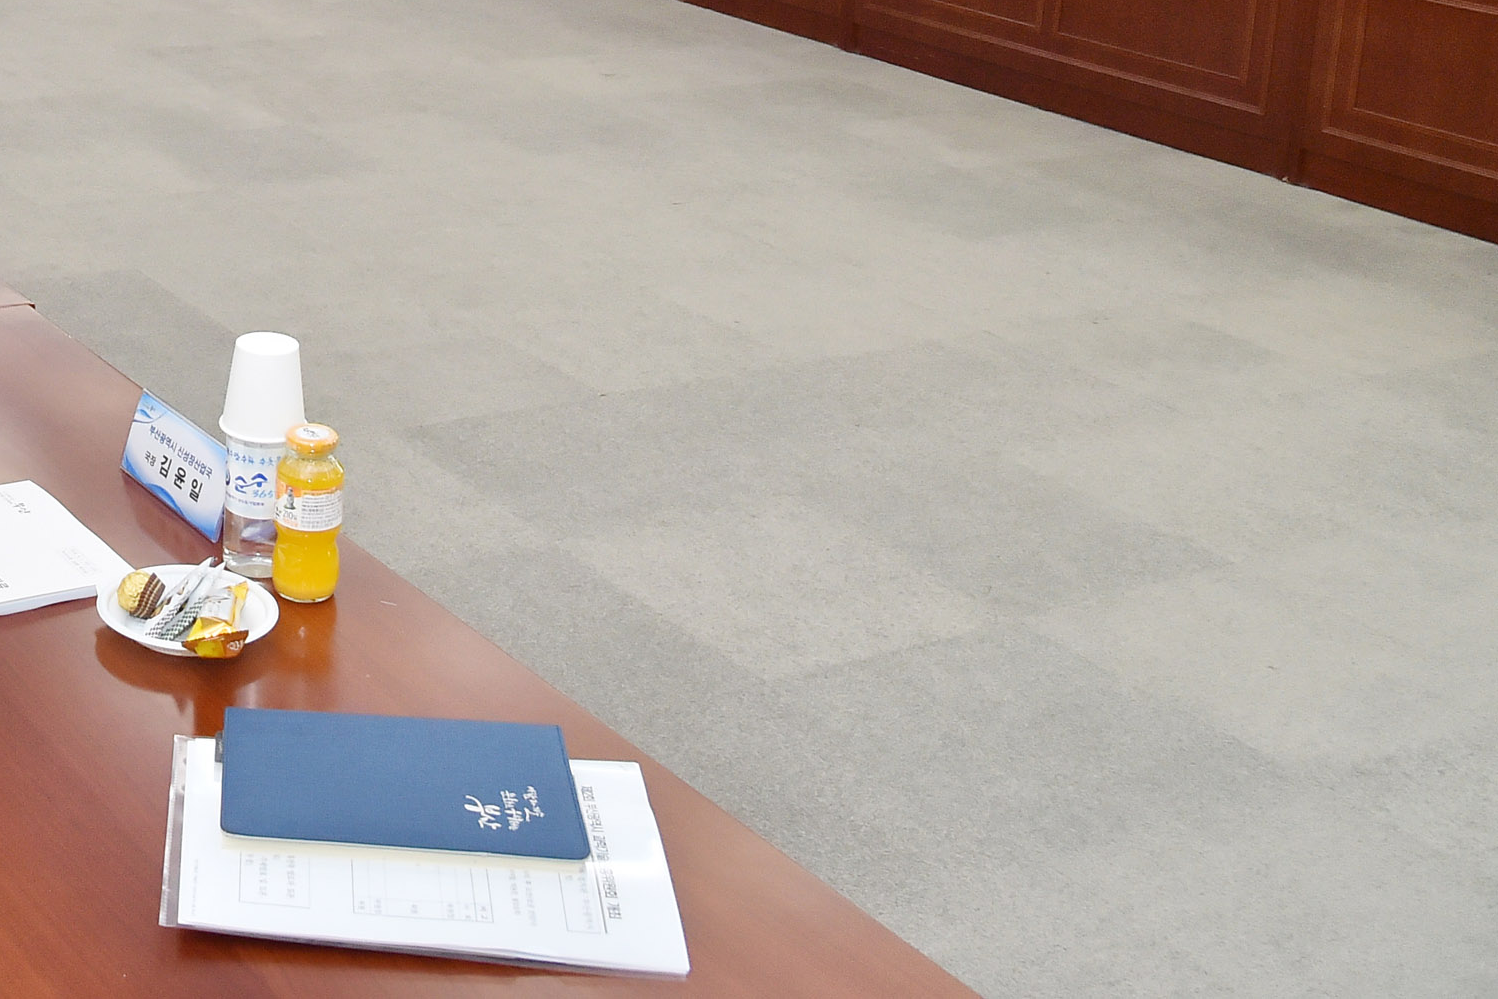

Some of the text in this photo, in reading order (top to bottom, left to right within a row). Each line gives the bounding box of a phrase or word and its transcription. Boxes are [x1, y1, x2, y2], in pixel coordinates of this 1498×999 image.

[144, 450, 157, 467] 국장
[149, 425, 178, 452] 부산광역시
[177, 446, 214, 480] 신성장산업국
[464, 795, 502, 830] 부산
